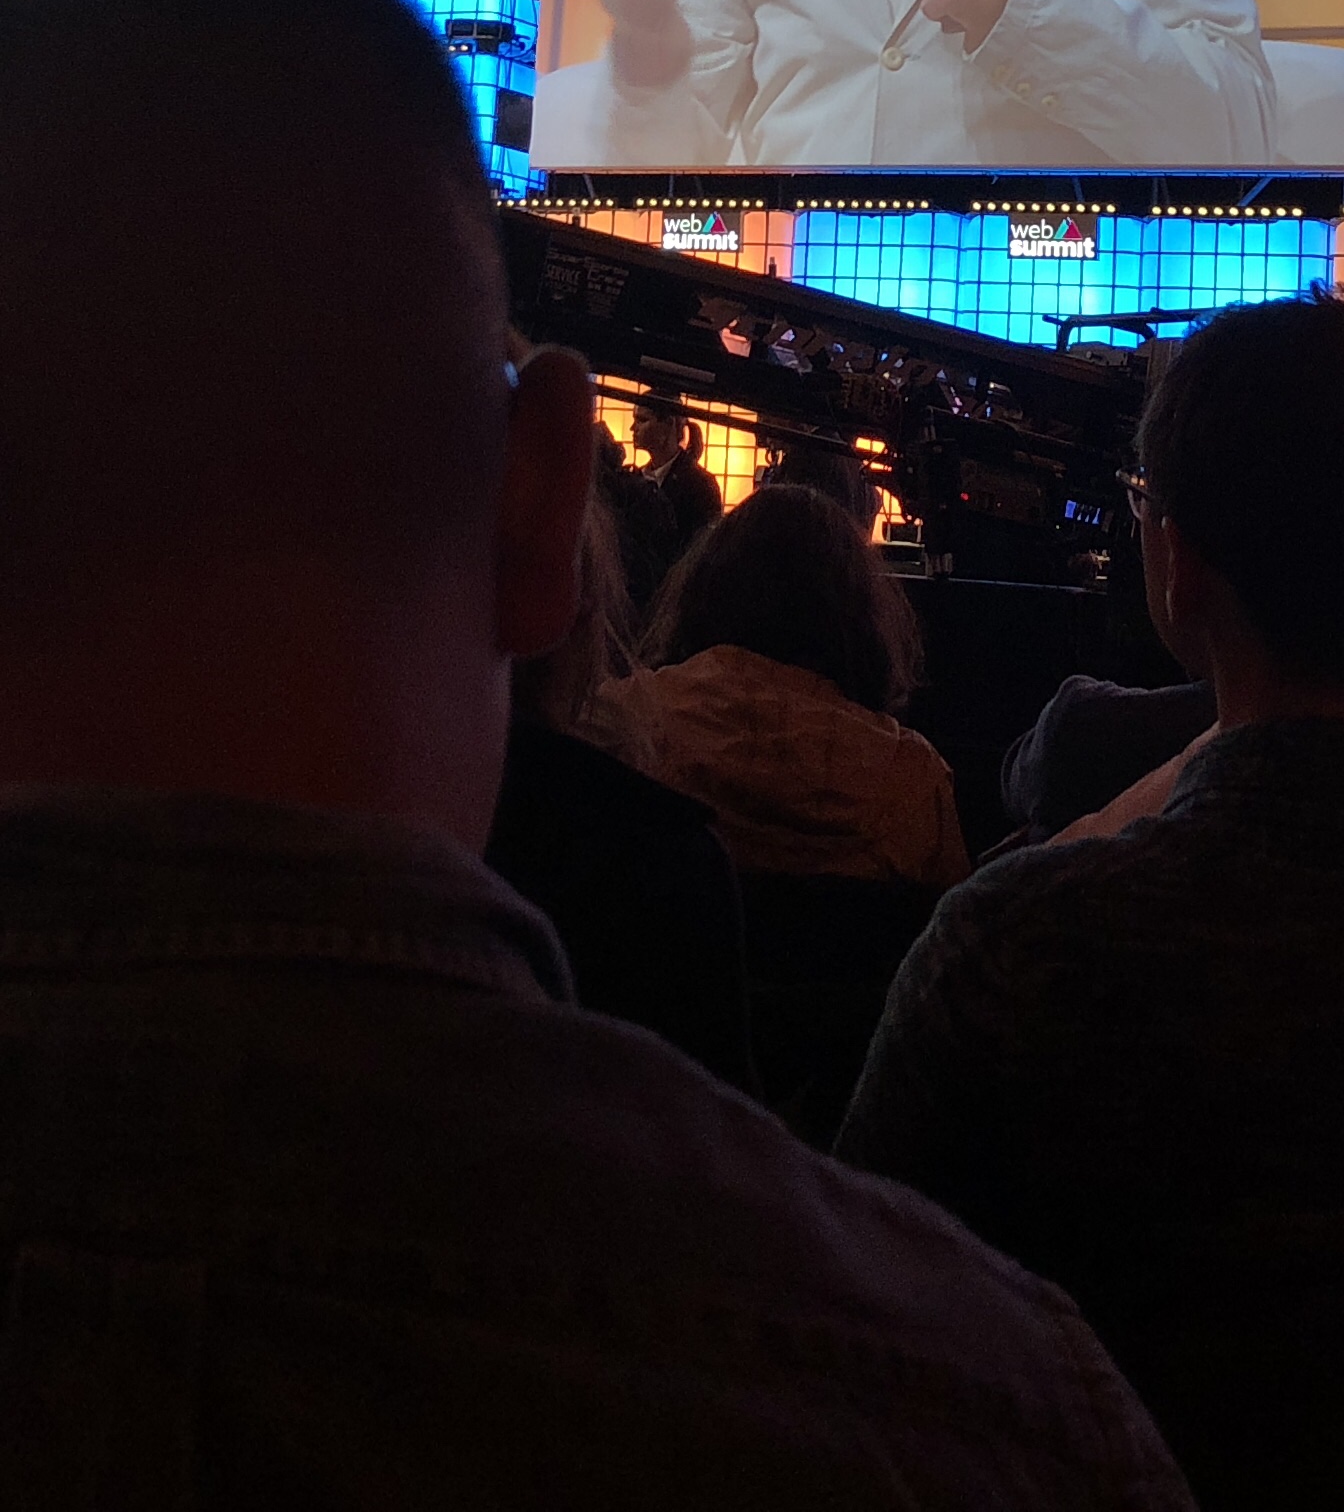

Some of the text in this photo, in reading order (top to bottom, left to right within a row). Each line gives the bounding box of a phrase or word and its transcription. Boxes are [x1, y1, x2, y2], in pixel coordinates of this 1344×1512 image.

[664, 213, 702, 233] web
[1010, 218, 1054, 239] web
[662, 230, 739, 251] summit
[1009, 237, 1096, 258] summit
